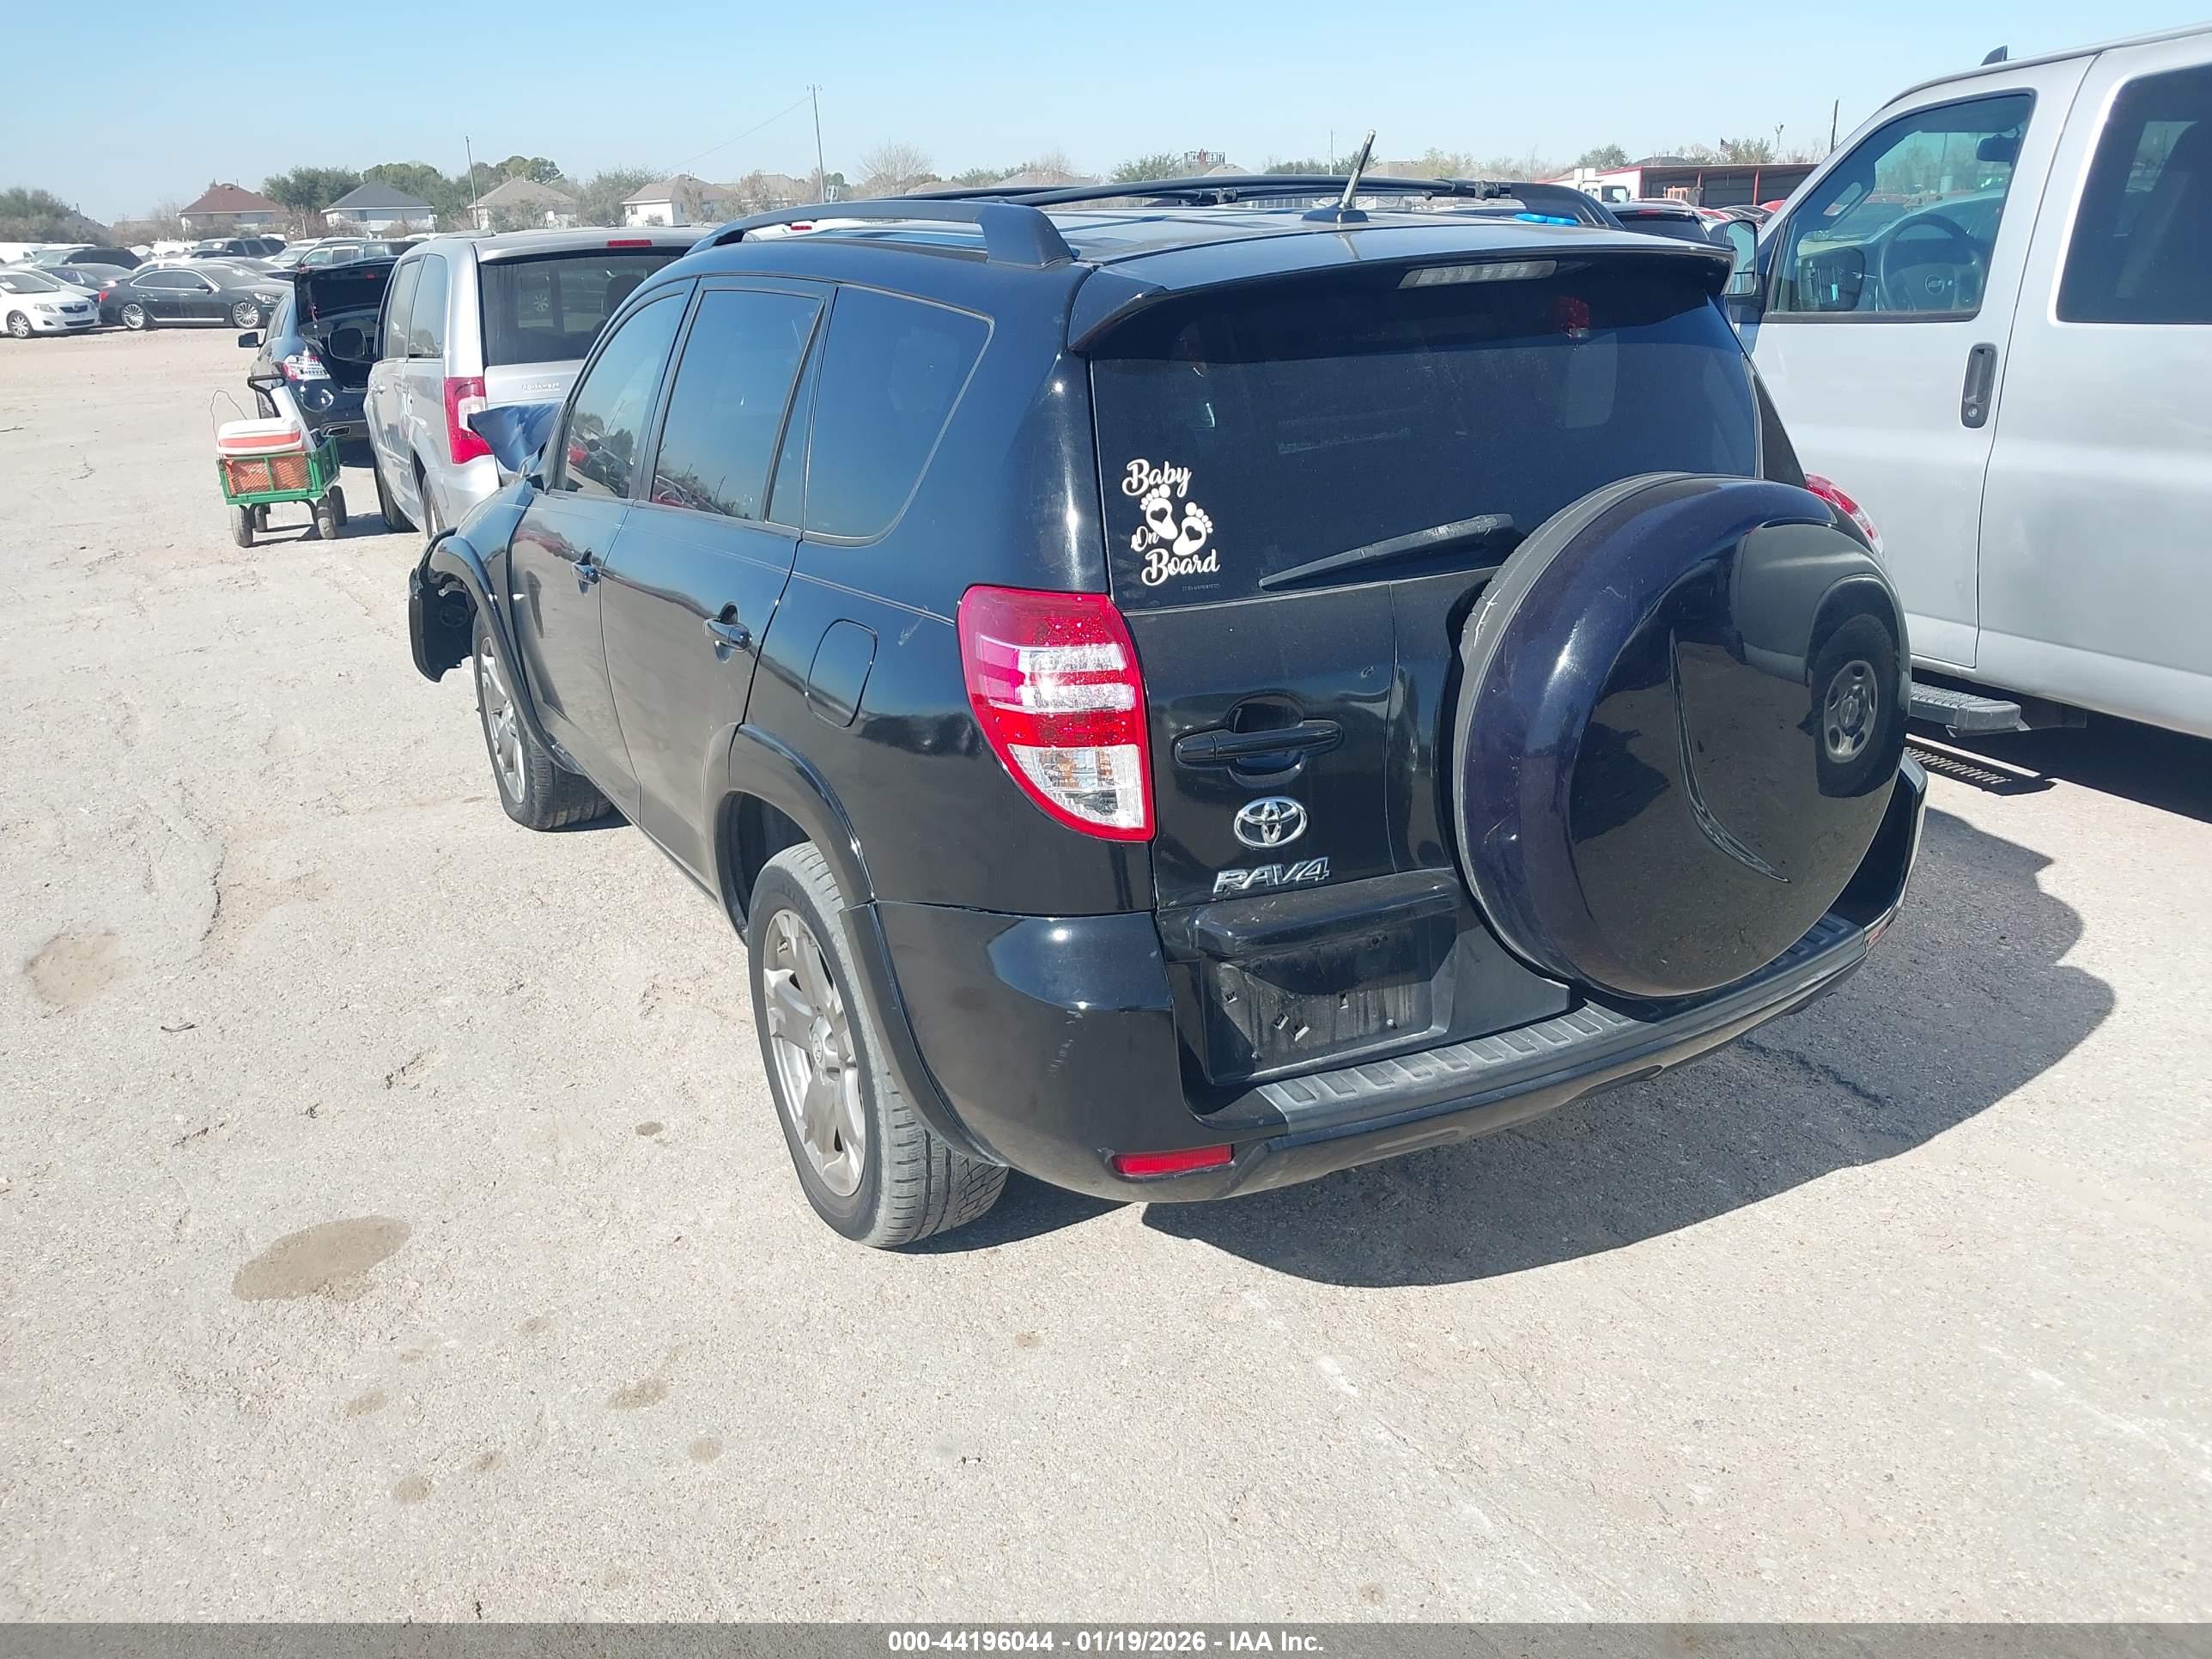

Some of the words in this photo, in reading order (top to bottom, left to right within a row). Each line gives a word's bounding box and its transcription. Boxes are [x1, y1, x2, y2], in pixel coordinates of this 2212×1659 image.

[1122, 459, 1192, 497] Baby
[1131, 526, 1159, 552] On
[1141, 548, 1220, 586] Board
[1213, 857, 1330, 894] RAV4
